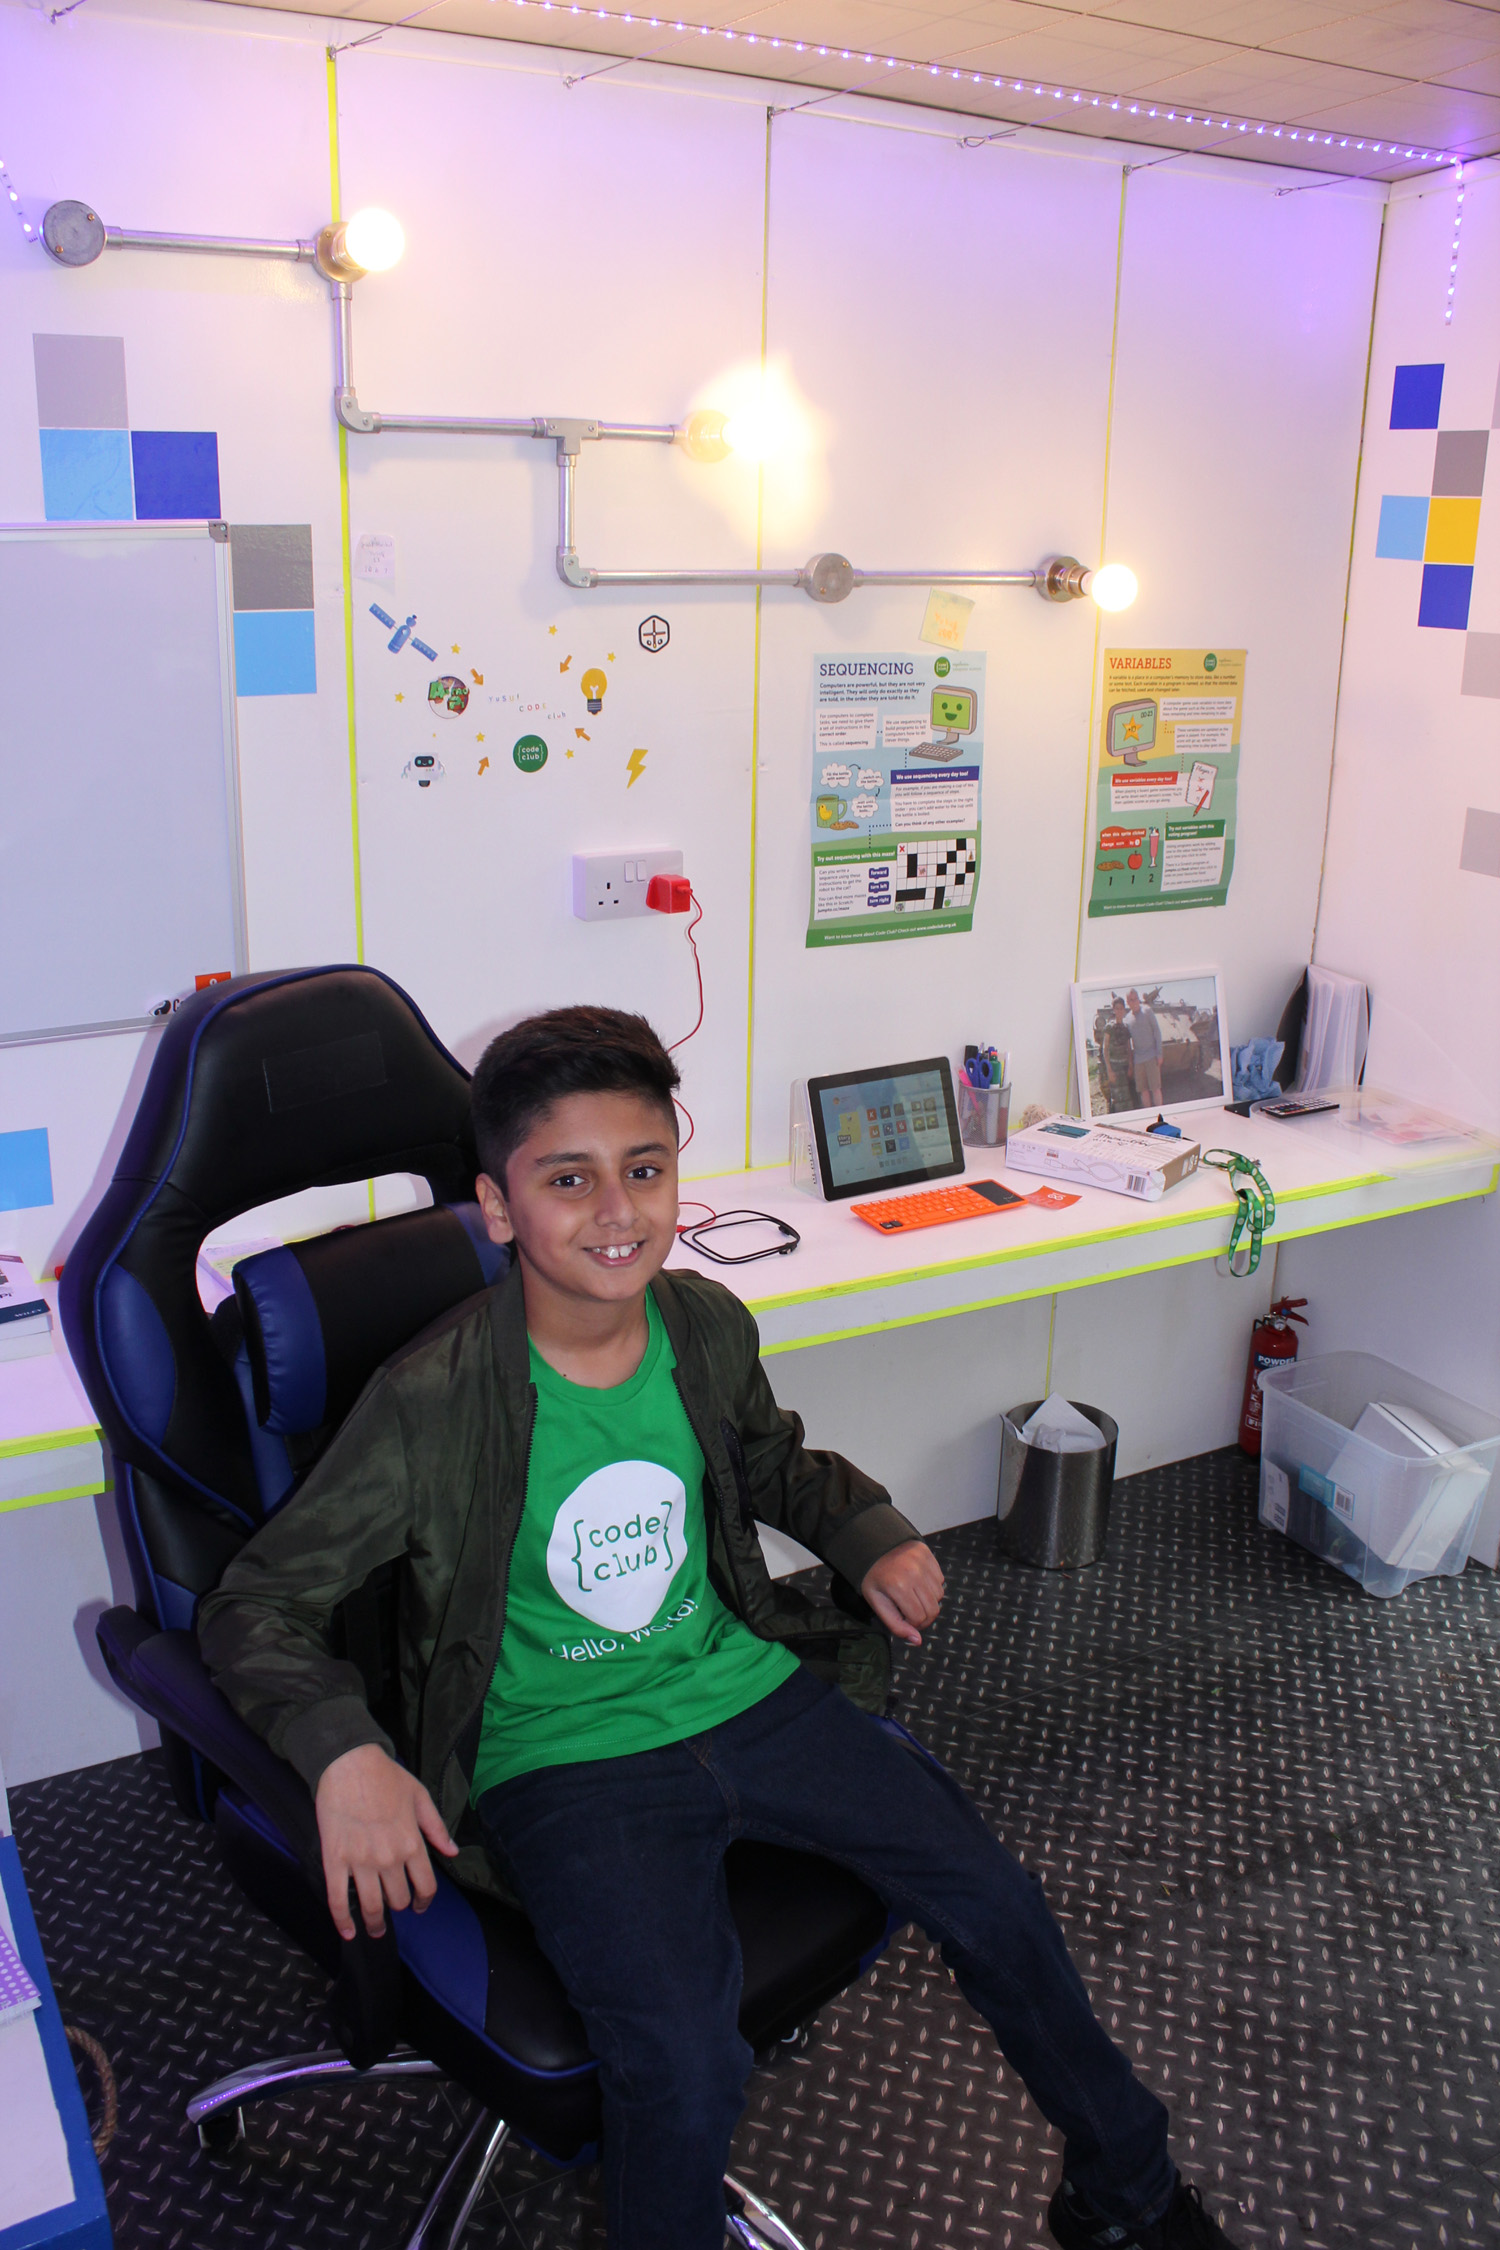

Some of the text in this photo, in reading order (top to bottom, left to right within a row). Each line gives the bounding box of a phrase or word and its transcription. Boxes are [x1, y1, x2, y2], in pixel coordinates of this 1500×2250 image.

[820, 662, 914, 676] SEQUENCING
[1109, 658, 1172, 669] VARIABLES
[1149, 873, 1153, 883] 2
[589, 1514, 660, 1547] code
[594, 1545, 657, 1580] club
[550, 1639, 625, 1662] Hello,
